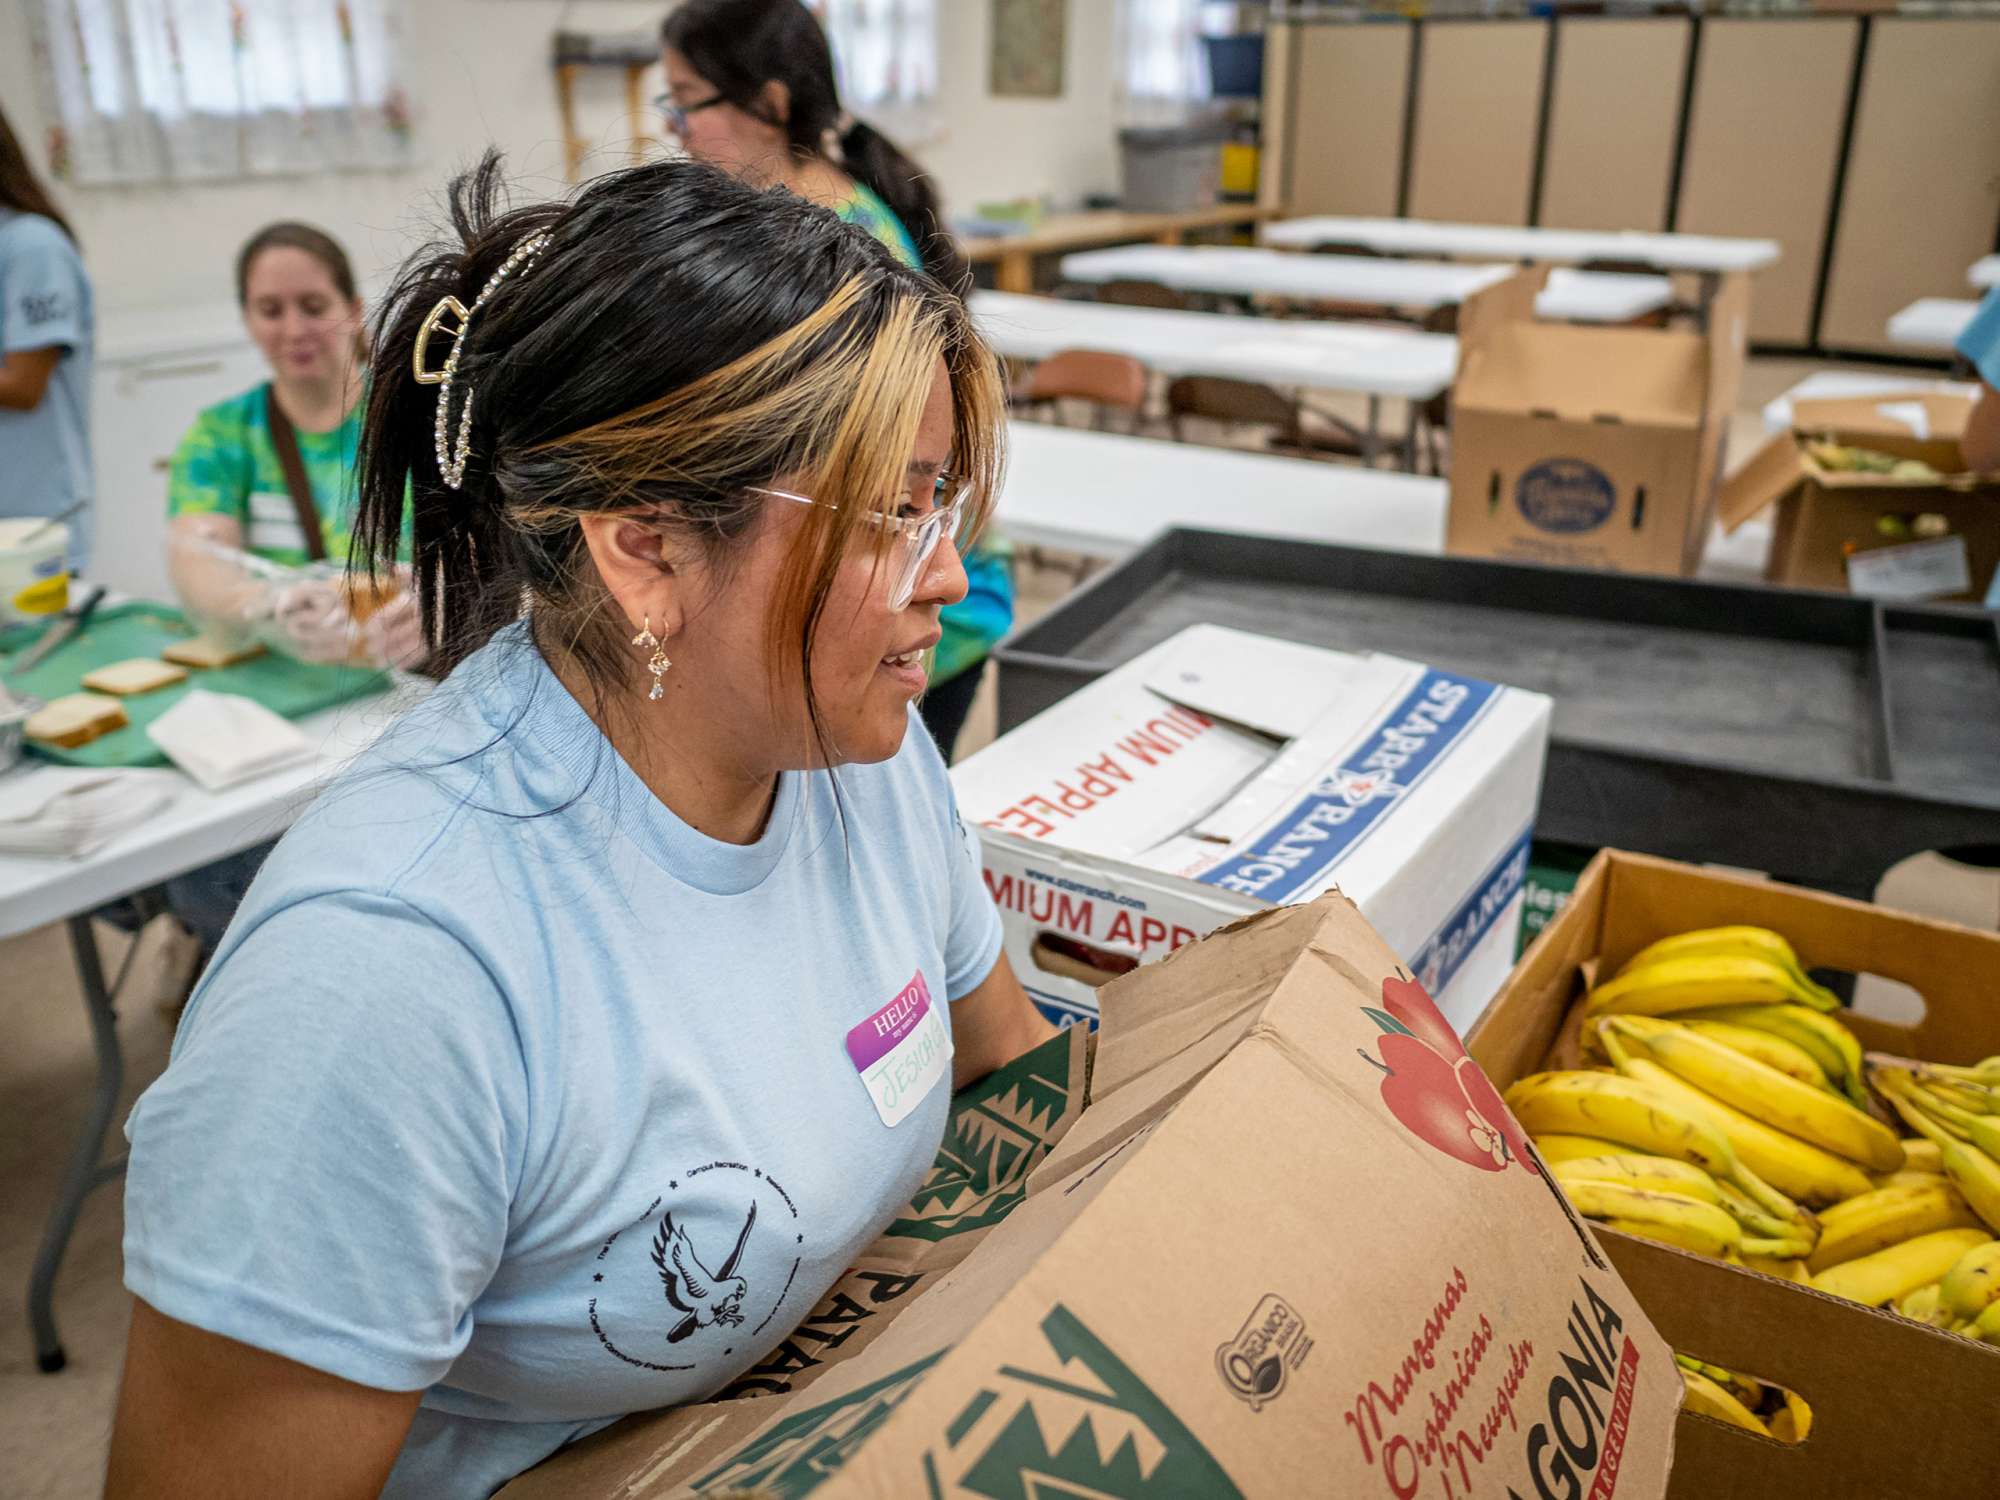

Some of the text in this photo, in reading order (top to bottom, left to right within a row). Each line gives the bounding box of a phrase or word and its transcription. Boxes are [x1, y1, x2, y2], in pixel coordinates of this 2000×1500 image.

[1362, 679, 1470, 770] STARR
[1024, 867, 1147, 911] www.starranch.com
[873, 986, 919, 1036] HELLO
[686, 1160, 749, 1178] Campus Recreation
[588, 1297, 598, 1314] The
[604, 1341, 643, 1368] Community
[1344, 1266, 1467, 1465] Manzanas
[1382, 1312, 1493, 1500] Orgánicas
[1506, 1274, 1623, 1500] GONIA
[1594, 1361, 1634, 1500] ARGENTINA
